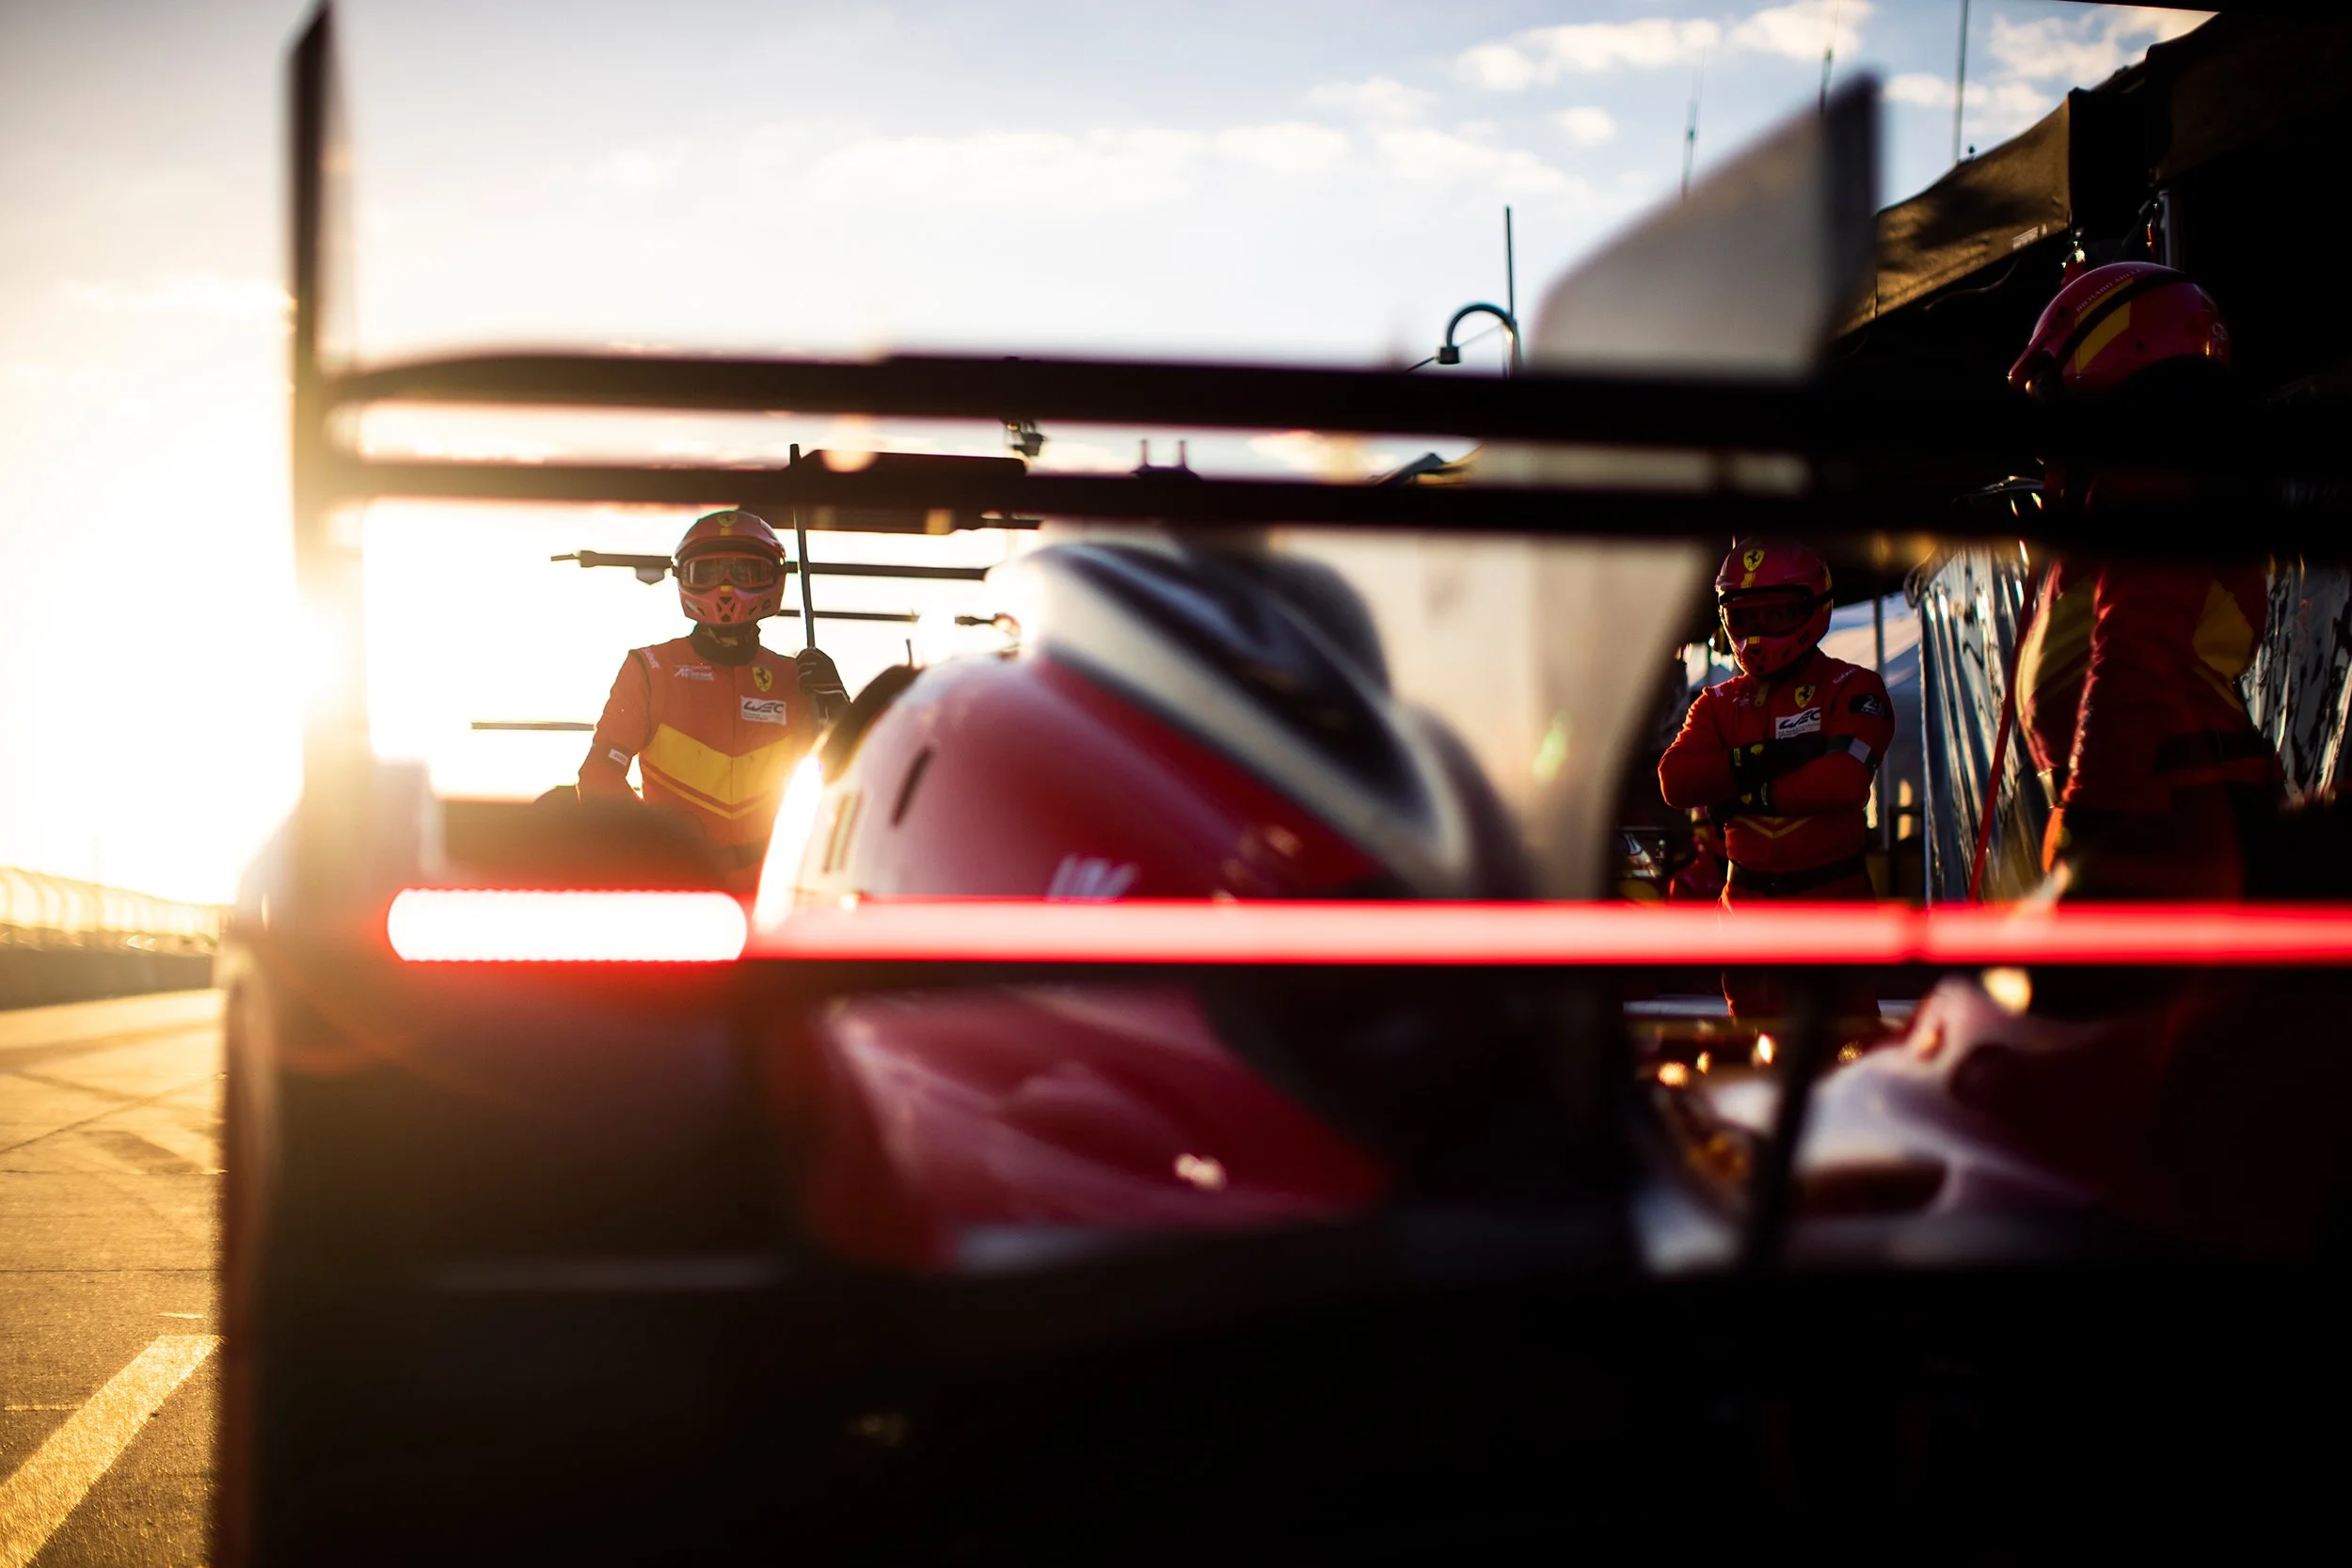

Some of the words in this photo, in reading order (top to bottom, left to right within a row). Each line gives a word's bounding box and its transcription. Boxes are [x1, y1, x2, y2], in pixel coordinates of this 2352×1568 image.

[2076, 282, 2113, 312] RICHARD
[743, 701, 785, 714] WEC
[1779, 709, 1822, 730] WEC
